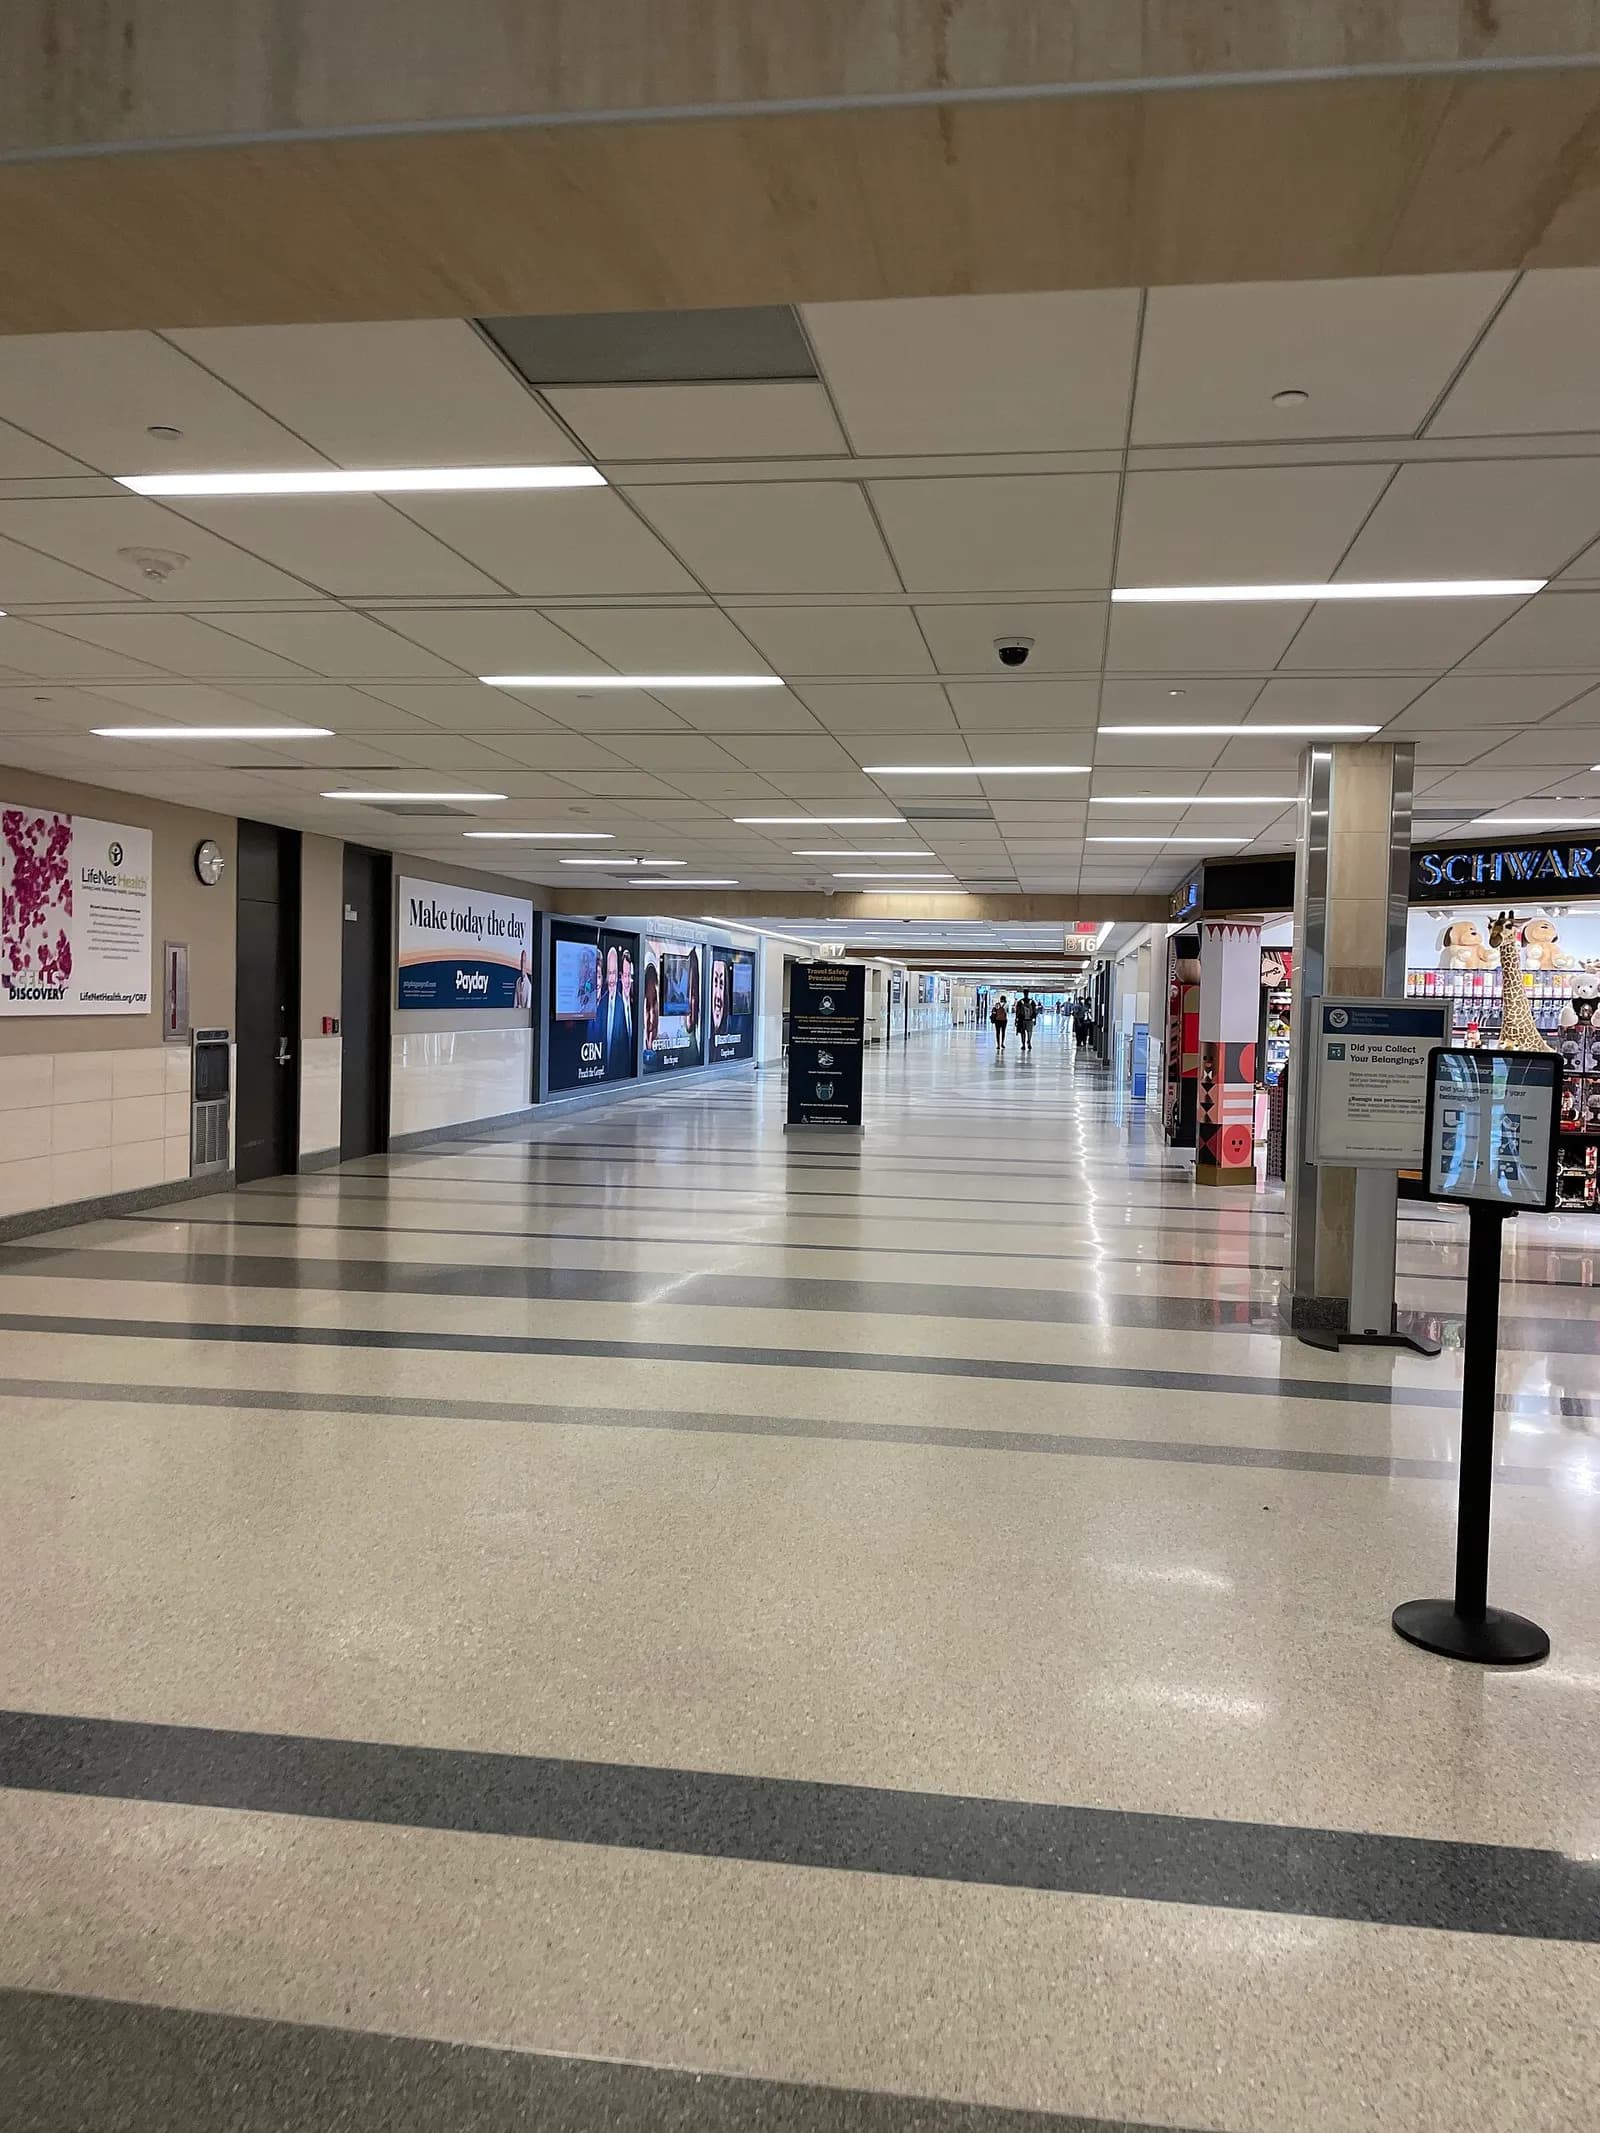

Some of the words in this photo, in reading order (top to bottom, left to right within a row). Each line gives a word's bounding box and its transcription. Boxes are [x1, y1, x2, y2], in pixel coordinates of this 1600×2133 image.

[81, 867, 117, 886] LifeNet
[118, 874, 148, 889] Health
[409, 898, 447, 930] Make
[450, 906, 485, 941] today
[487, 909, 506, 936] the
[507, 913, 526, 945] day
[1065, 936, 1096, 952] B16
[828, 969, 849, 977] Safety
[455, 969, 489, 994] Payday
[9, 984, 69, 1000] DISCOVERY
[580, 1042, 603, 1062] CBN
[1350, 1043, 1365, 1052] Did
[1367, 1045, 1383, 1054] you
[1385, 1045, 1417, 1054] Collect
[1350, 1054, 1369, 1063] Your
[1371, 1055, 1425, 1066] Belongings?
